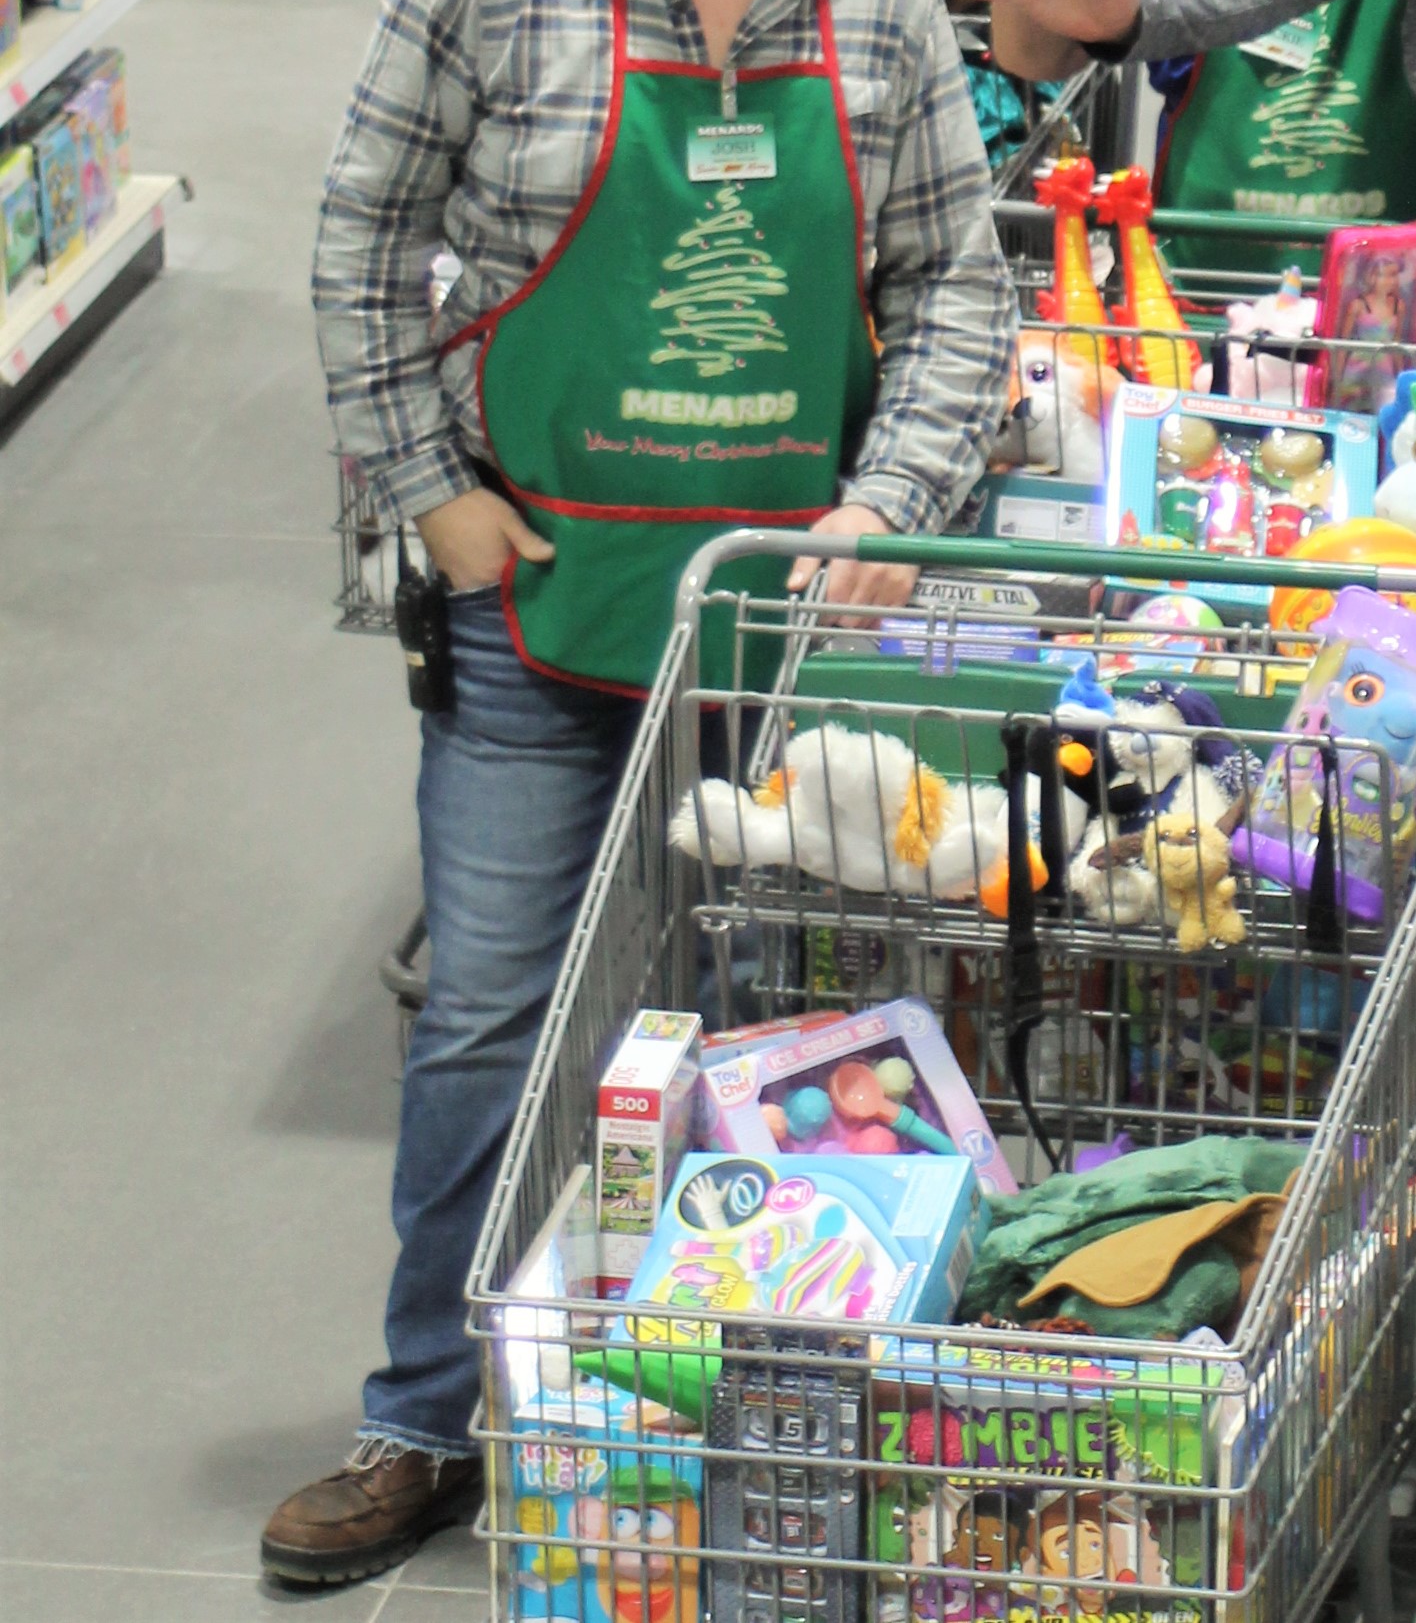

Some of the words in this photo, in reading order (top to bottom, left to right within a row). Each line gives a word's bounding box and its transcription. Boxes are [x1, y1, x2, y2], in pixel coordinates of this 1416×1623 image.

[709, 139, 756, 156] JOSH
[620, 386, 799, 429] MENARDS
[913, 581, 977, 601] REATIVE
[768, 1052, 798, 1069] ICE
[800, 1032, 853, 1056] CREAM
[855, 1020, 886, 1038] SET
[713, 1069, 741, 1085] Toy
[718, 1080, 752, 1100] Chef
[612, 1096, 650, 1112] 500
[711, 1273, 739, 1309] GLOW
